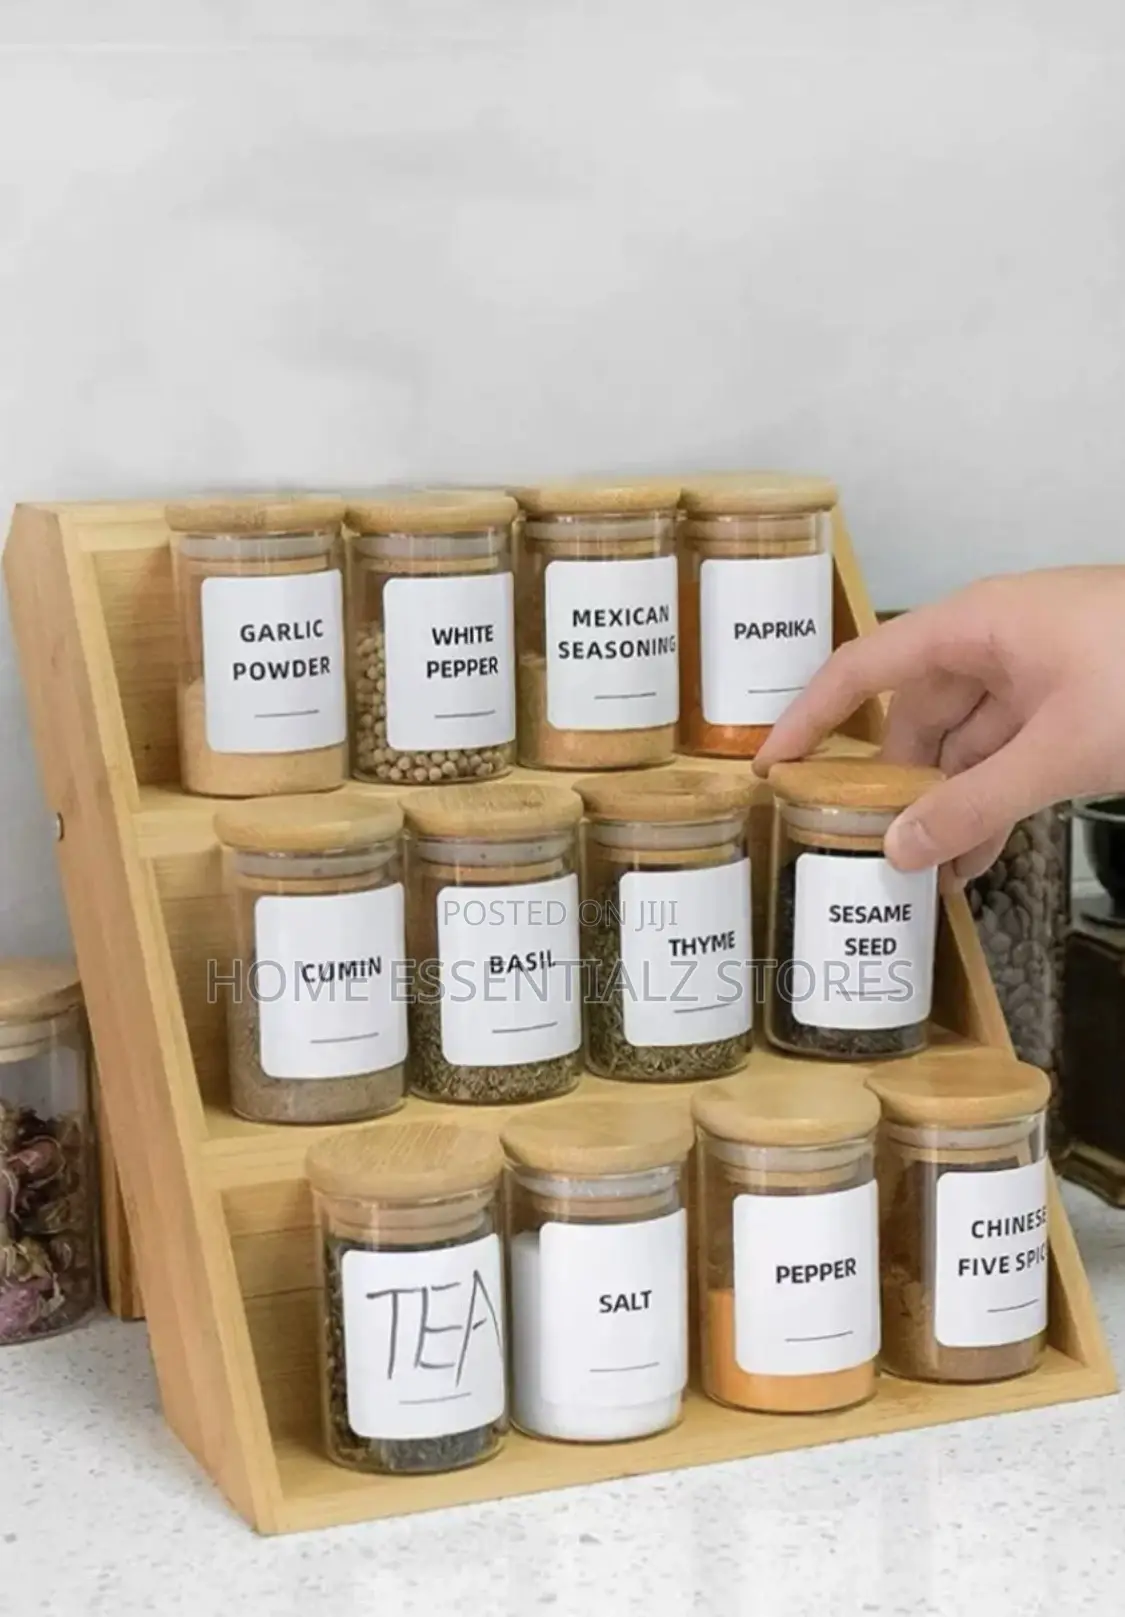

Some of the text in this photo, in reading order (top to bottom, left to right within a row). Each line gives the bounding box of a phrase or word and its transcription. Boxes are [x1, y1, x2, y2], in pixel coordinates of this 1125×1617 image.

[572, 604, 670, 628] MEXICAN
[733, 616, 817, 641] PAPRIKA
[240, 618, 324, 644] GARLIC
[431, 622, 494, 646] WHITE
[558, 634, 676, 660] SEASONING
[232, 655, 331, 682] POWDER
[426, 655, 499, 680] PEPPER
[828, 902, 912, 925] SESAME
[668, 929, 737, 958] THYME
[844, 935, 897, 957] SEED
[301, 955, 383, 985] CUMIN
[489, 948, 557, 976] BASIL
[970, 1204, 1047, 1239] CHINESE
[775, 1257, 857, 1285] PEPPER
[957, 1253, 1011, 1278] FIVE
[598, 1290, 653, 1315] SALT
[366, 1269, 504, 1386] TEA
